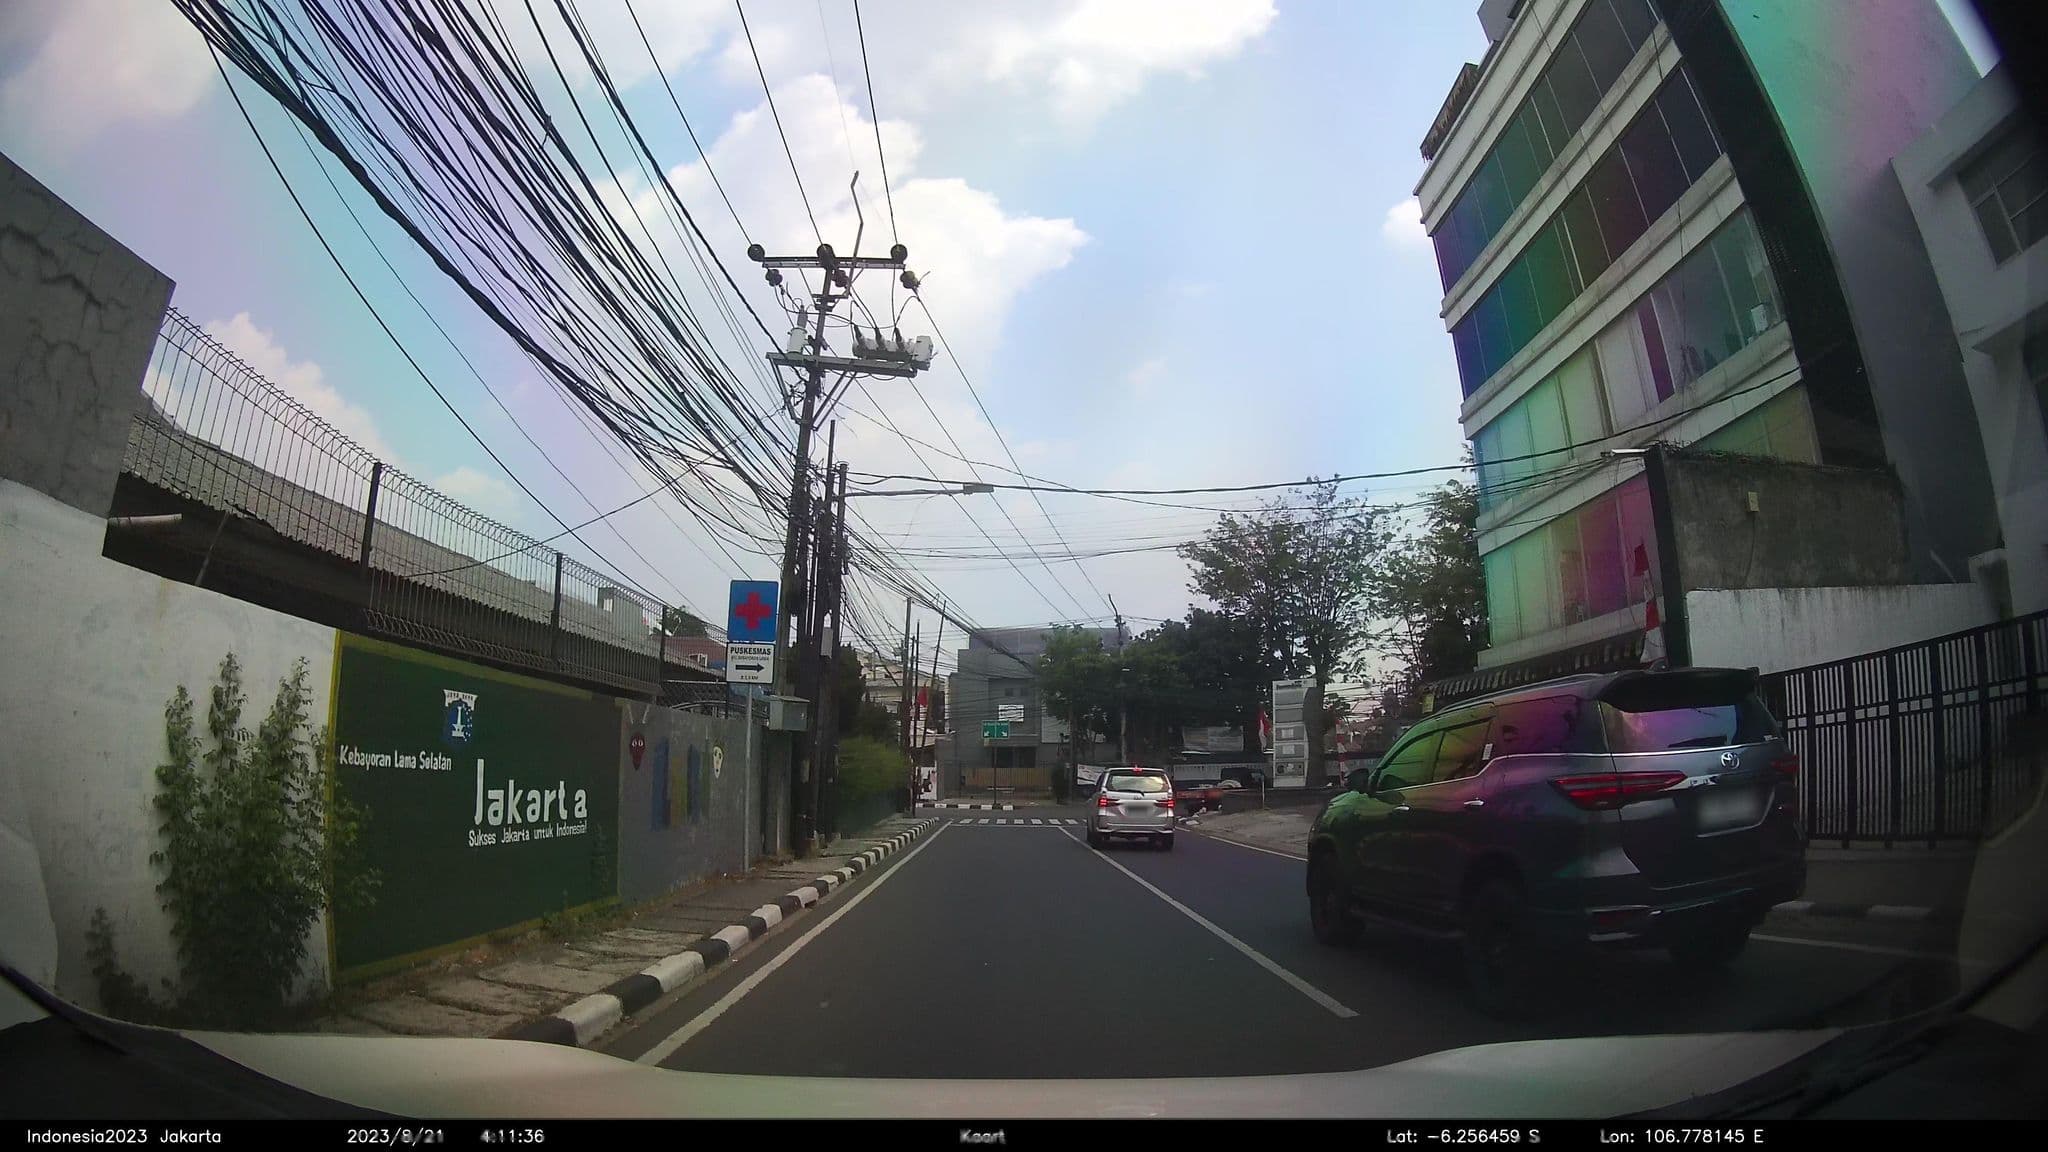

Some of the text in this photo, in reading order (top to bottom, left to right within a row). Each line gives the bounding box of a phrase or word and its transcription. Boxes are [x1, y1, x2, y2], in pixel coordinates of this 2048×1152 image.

[730, 647, 771, 656] PUSKESMAS
[339, 745, 452, 771] Kebayoran Lama Selatan
[474, 758, 588, 826] Jakarta
[468, 829, 497, 847] Sukses
[501, 827, 530, 844] Jakarta
[533, 823, 554, 839] untuk
